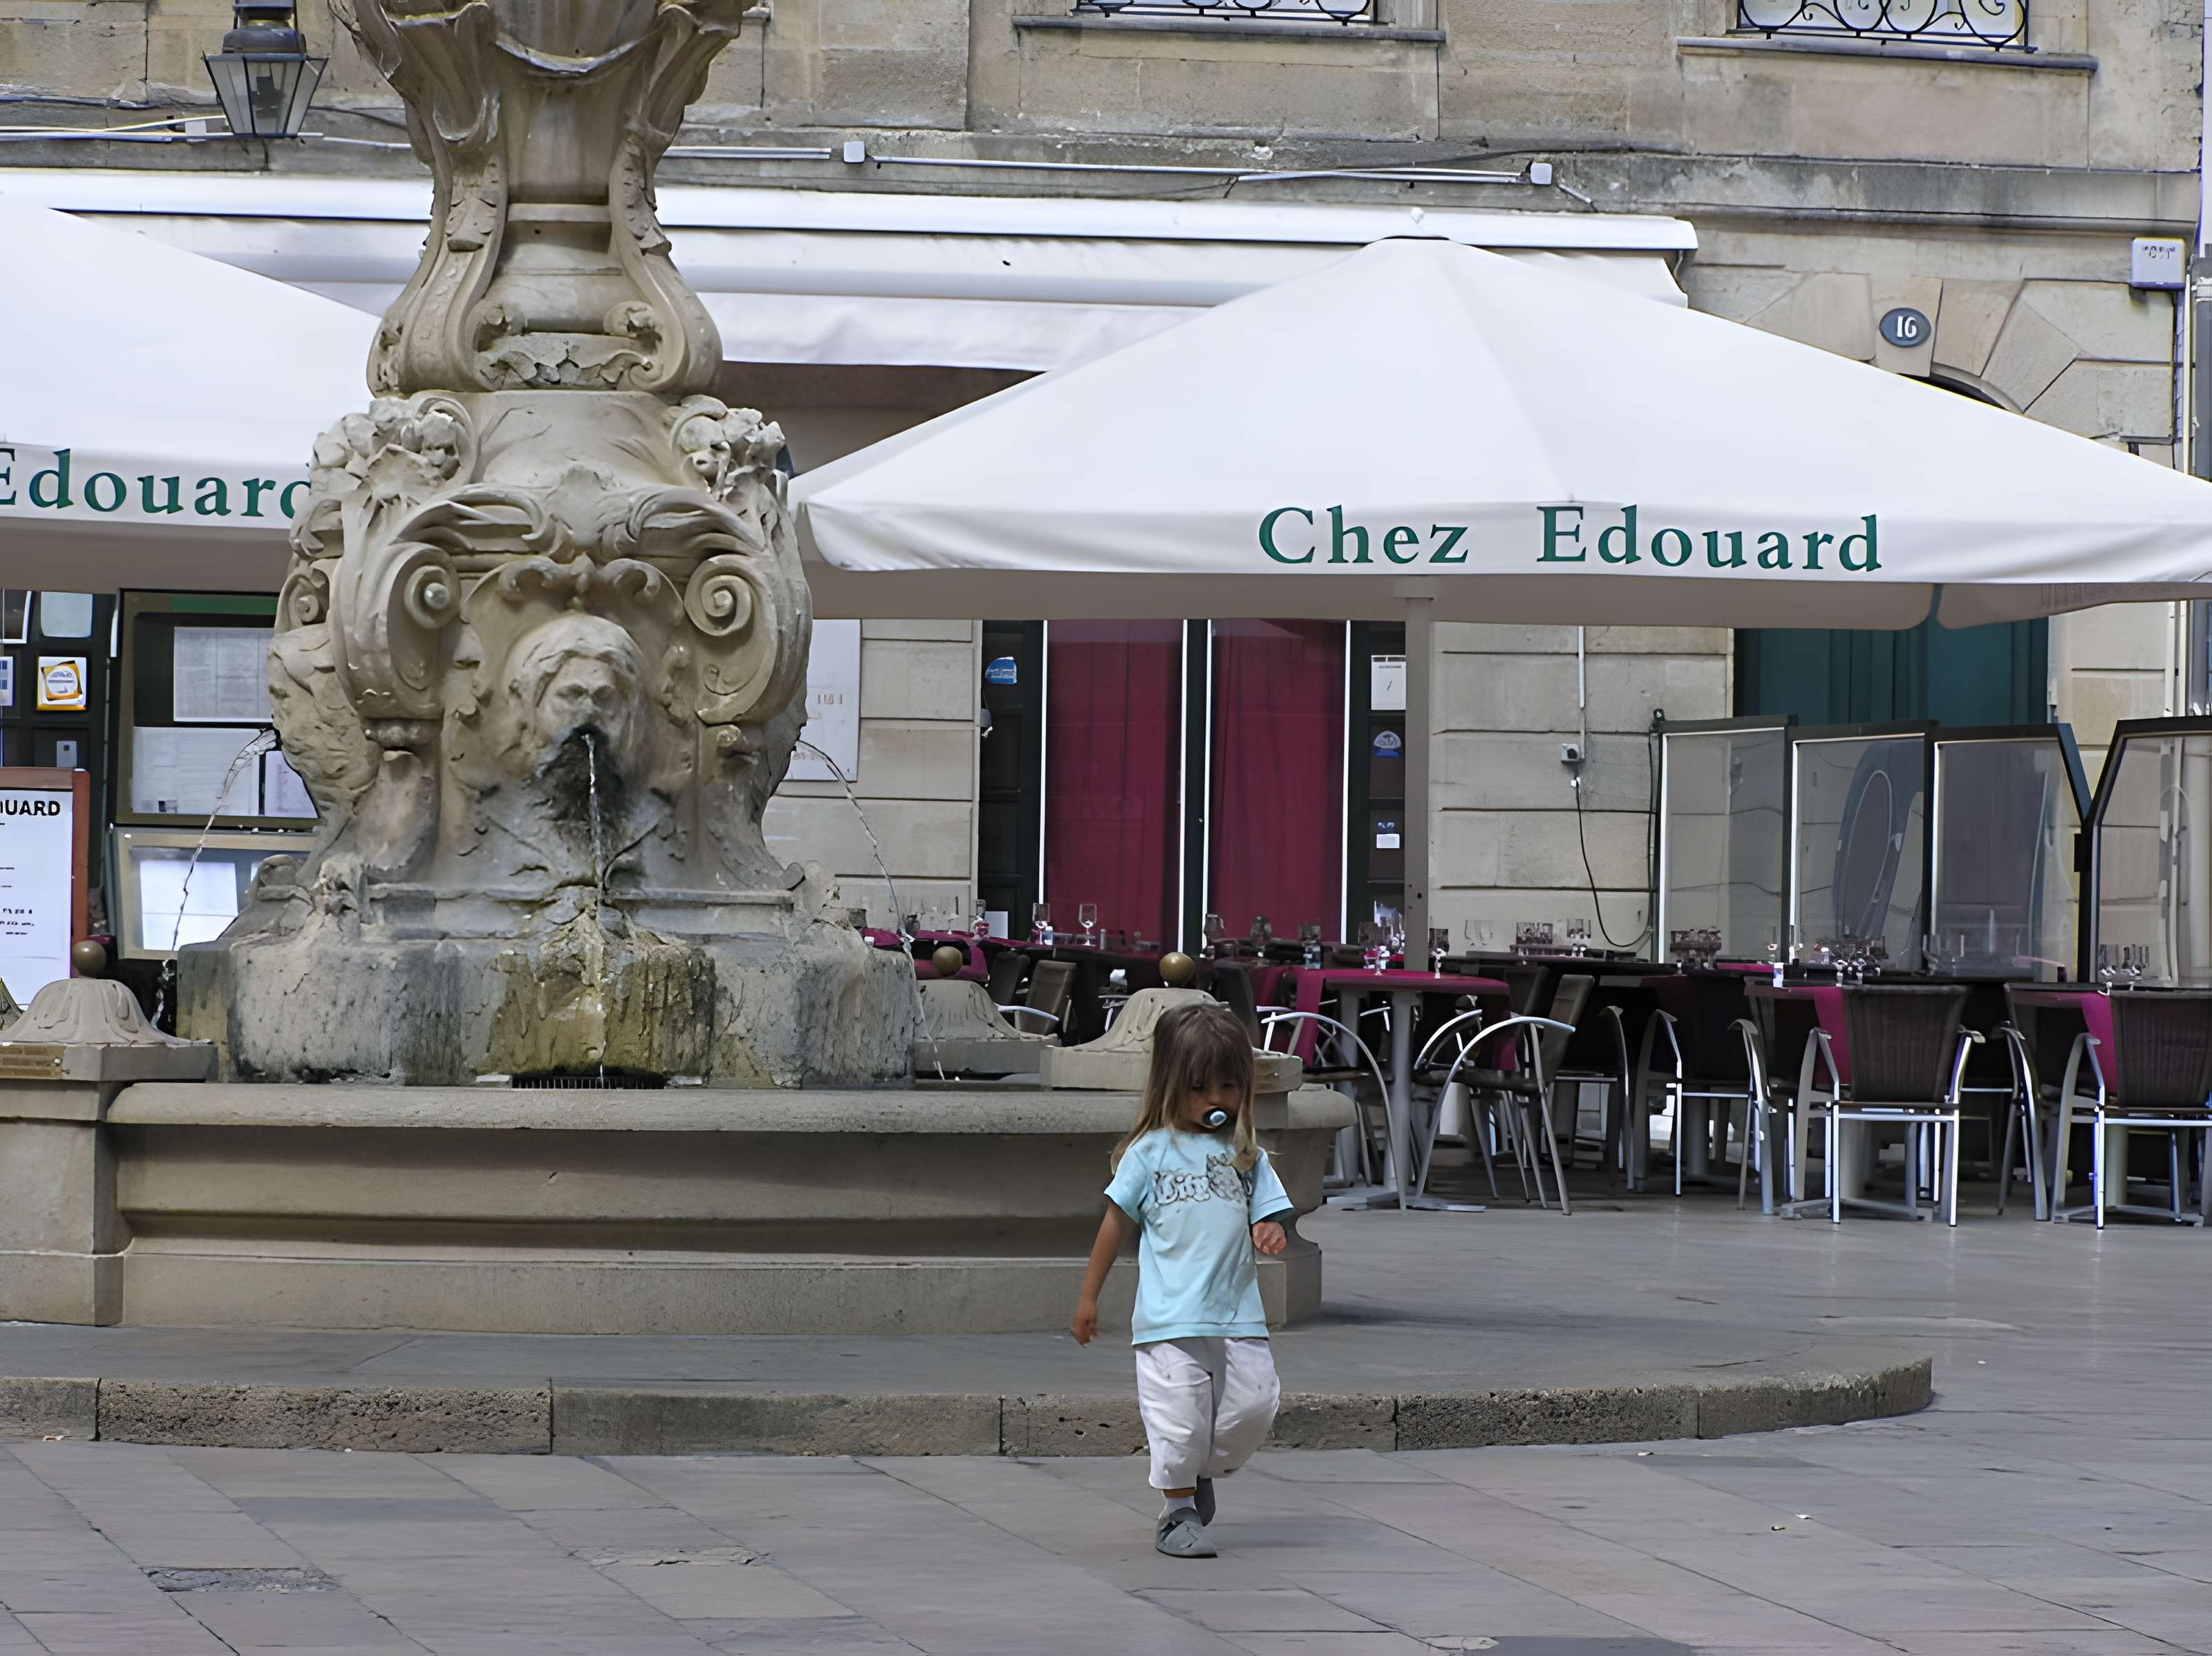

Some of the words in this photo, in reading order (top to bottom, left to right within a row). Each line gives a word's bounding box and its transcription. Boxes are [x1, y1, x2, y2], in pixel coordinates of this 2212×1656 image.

[1897, 315, 1918, 338] 16
[1257, 504, 1469, 565] Chez
[1536, 505, 1883, 573] Edouard
[0, 799, 62, 816] UARD
